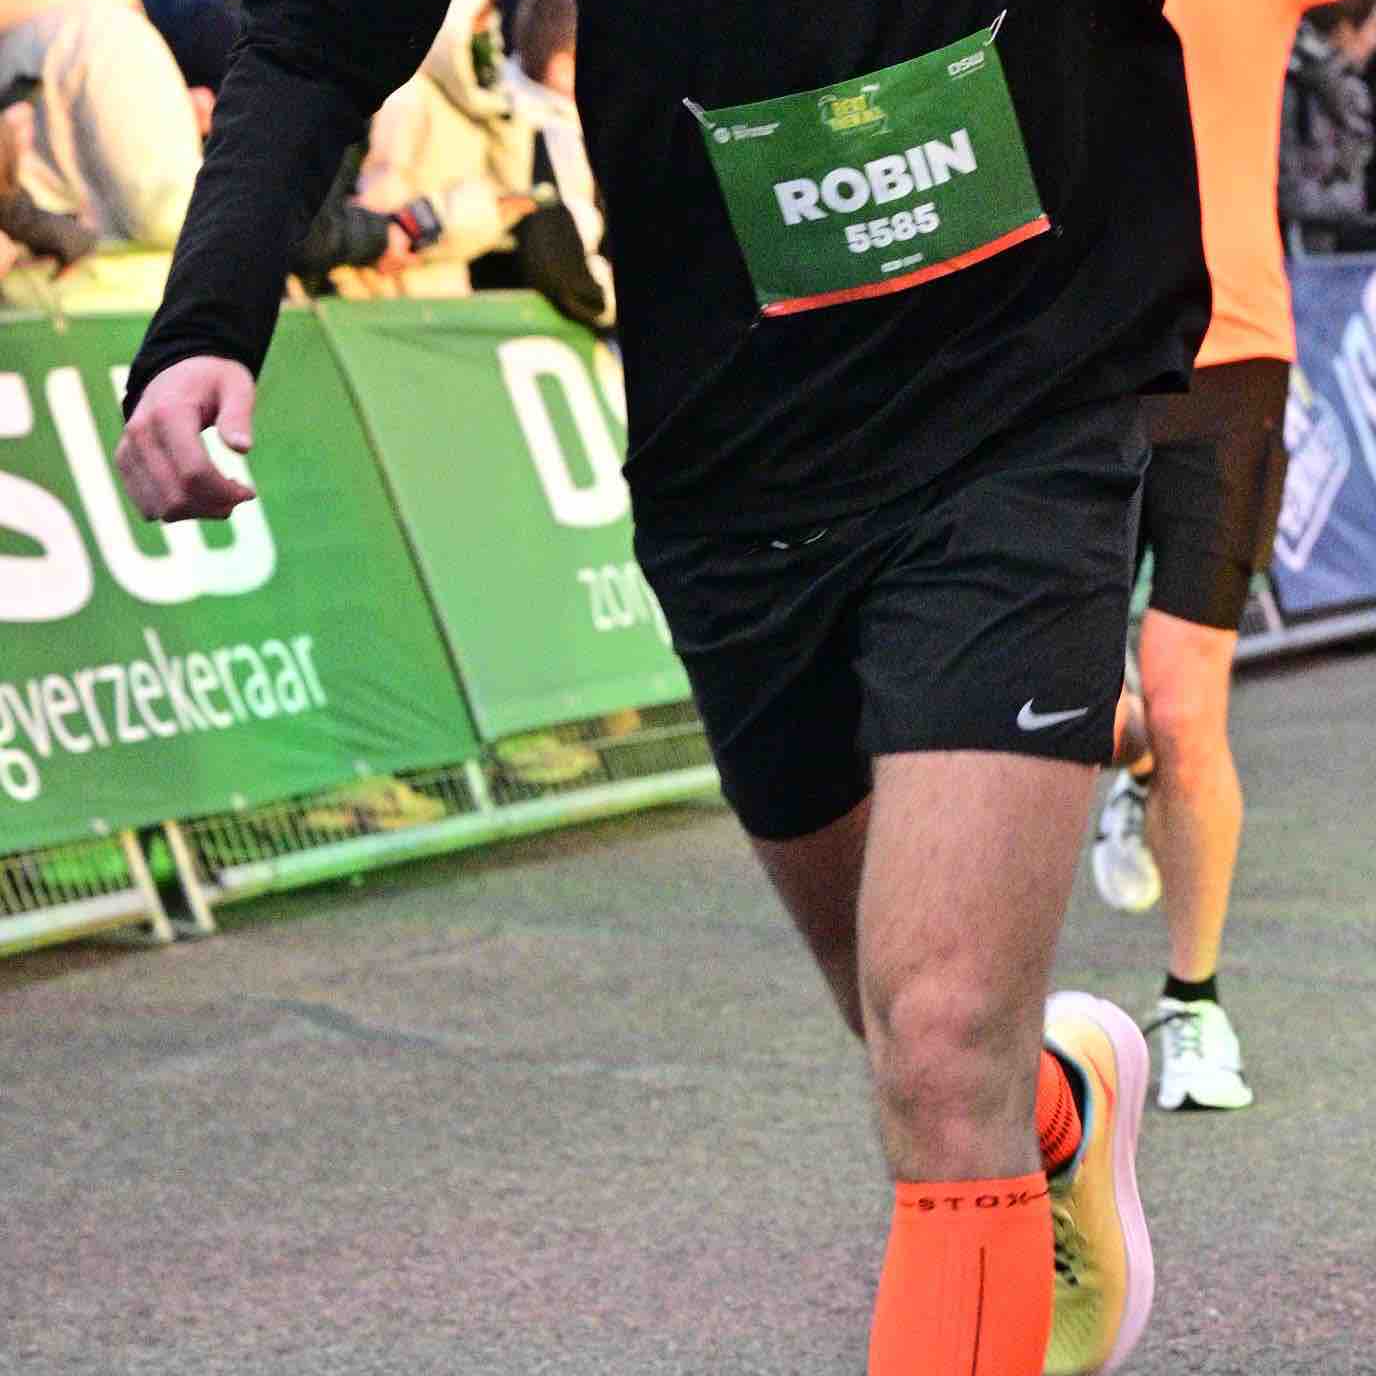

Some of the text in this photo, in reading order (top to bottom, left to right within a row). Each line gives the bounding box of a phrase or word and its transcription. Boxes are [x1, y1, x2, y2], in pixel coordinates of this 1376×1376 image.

[773, 127, 977, 226] ROBIN
[844, 201, 940, 254] 5585
[0, 365, 277, 622] SW
[918, 1190, 1031, 1212] STOX
